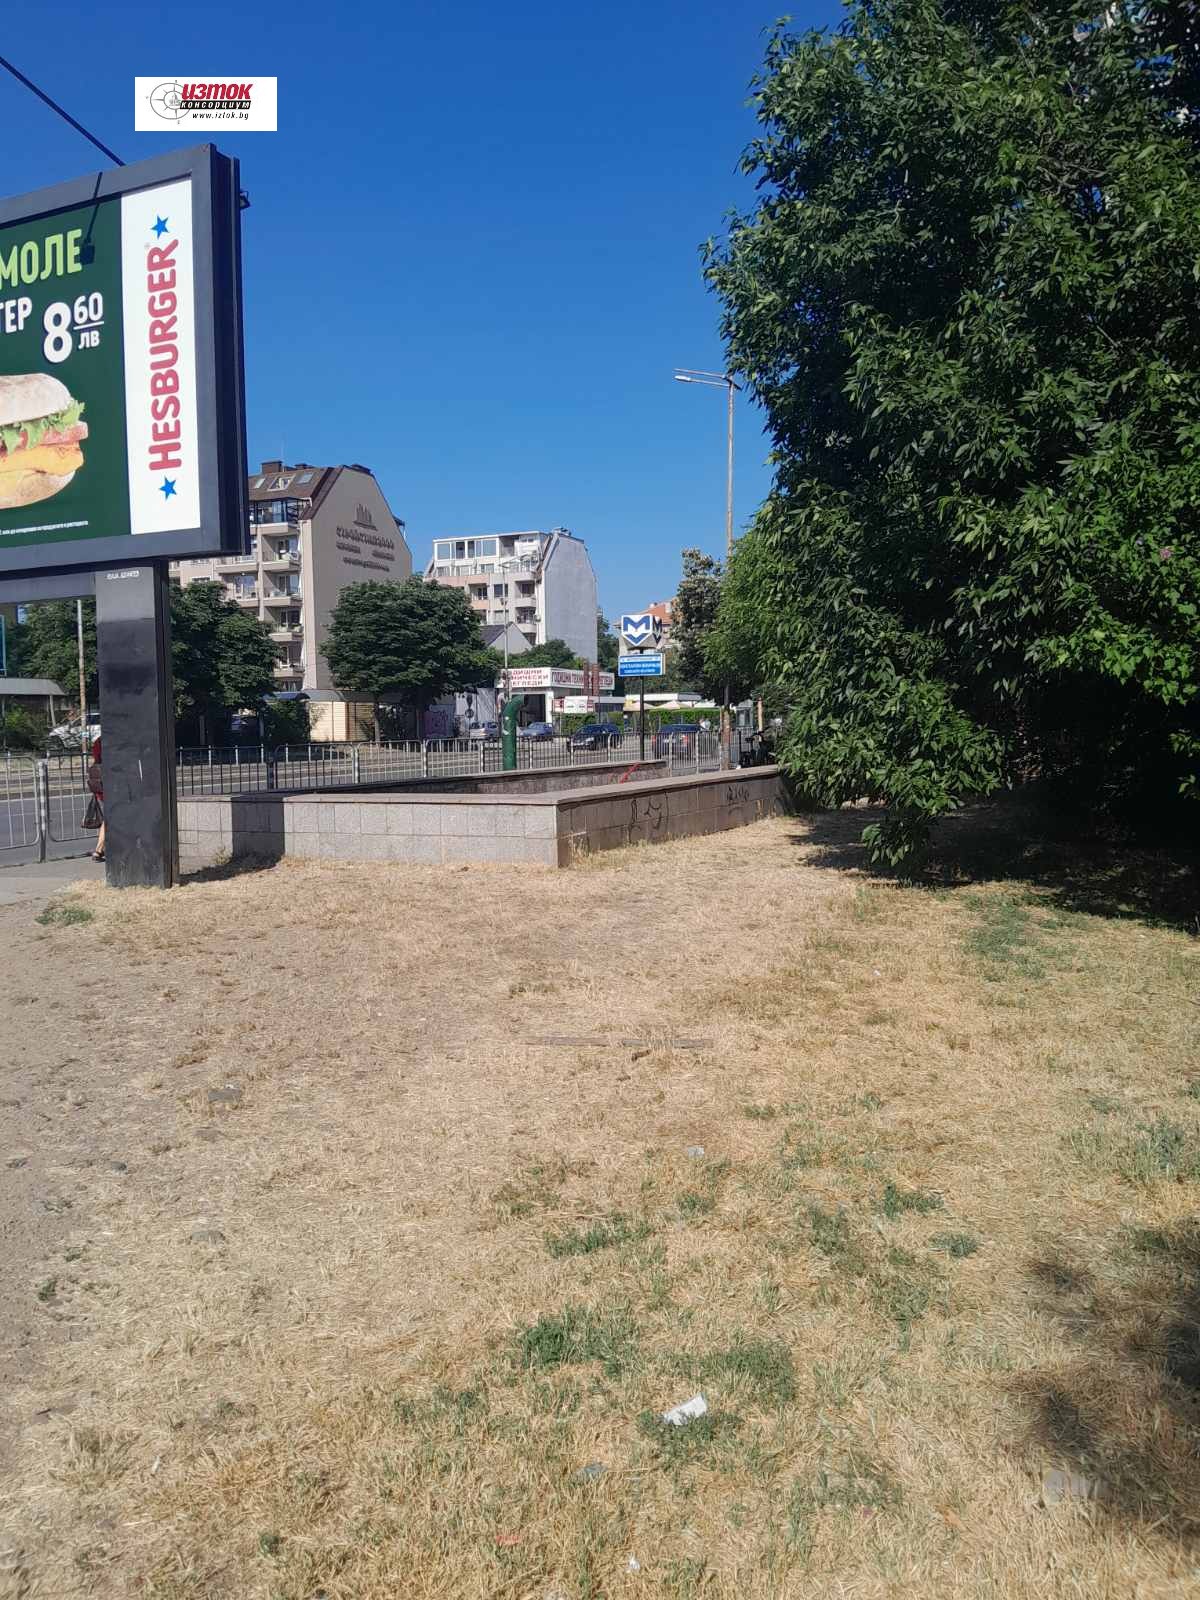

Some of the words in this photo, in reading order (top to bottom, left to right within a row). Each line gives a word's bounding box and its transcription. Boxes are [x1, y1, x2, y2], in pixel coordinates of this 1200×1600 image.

[43, 301, 73, 363] 8
[73, 291, 104, 325] 60
[147, 238, 182, 471] HESBURGER
